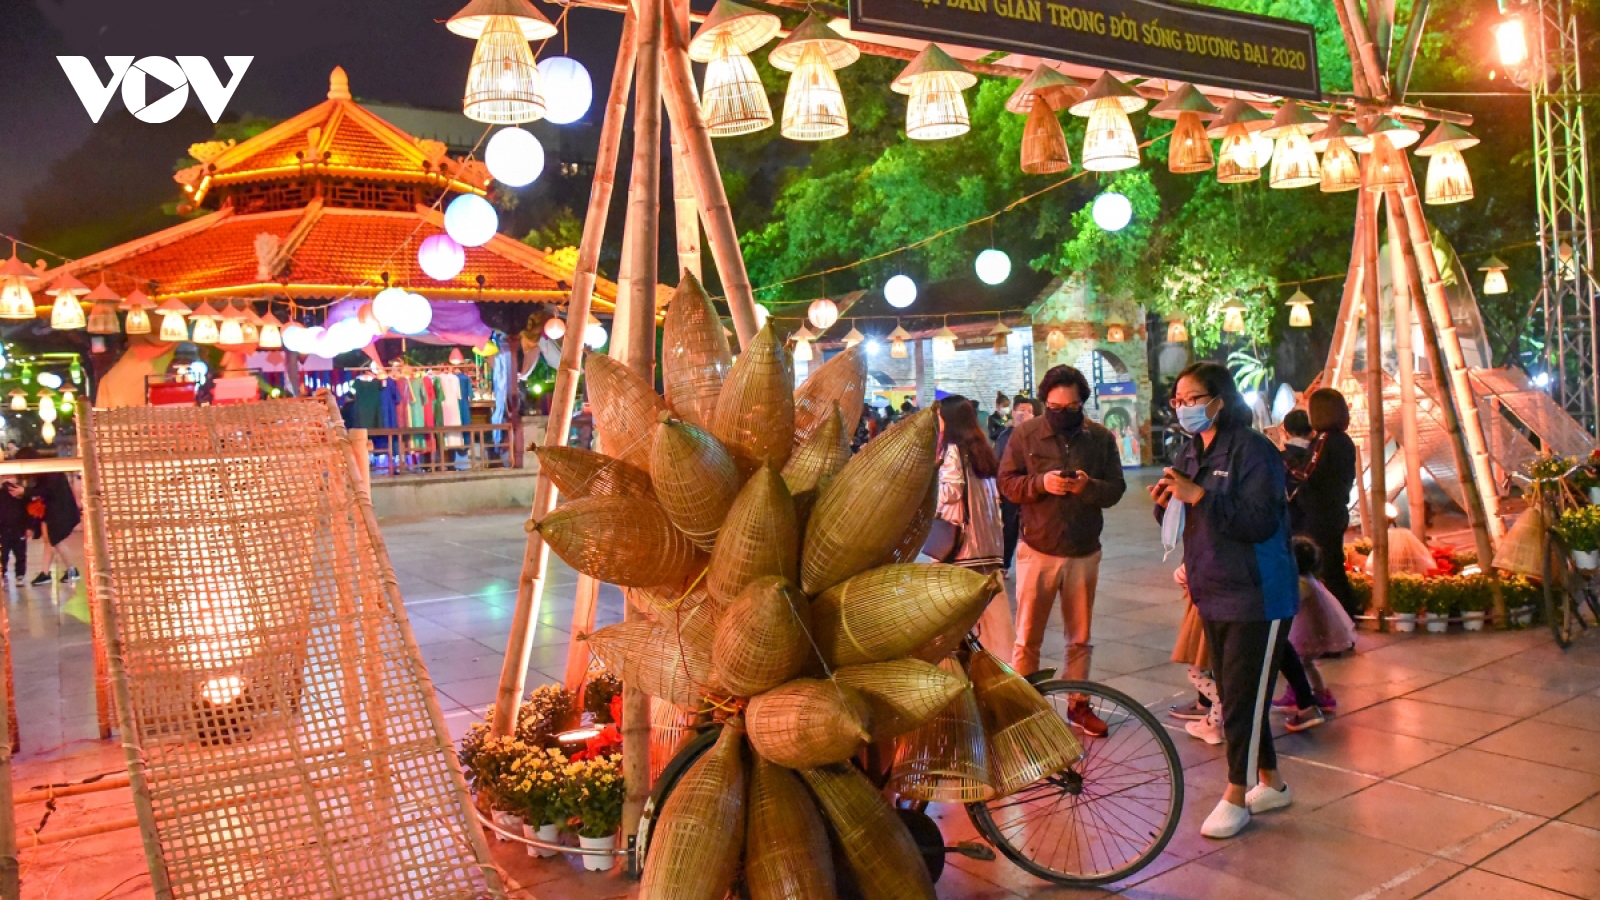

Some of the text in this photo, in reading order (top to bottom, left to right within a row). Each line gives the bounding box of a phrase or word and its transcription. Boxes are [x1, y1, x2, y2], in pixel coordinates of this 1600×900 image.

[994, 0, 1042, 23] GIAN
[1047, 2, 1106, 35] TRONG
[1109, 11, 1139, 42] ĐỜI
[1141, 18, 1182, 51] SỐNG
[1184, 32, 1241, 60] ĐƯƠNG
[1243, 42, 1269, 68] ĐẠI
[1271, 46, 1306, 71] 2020
